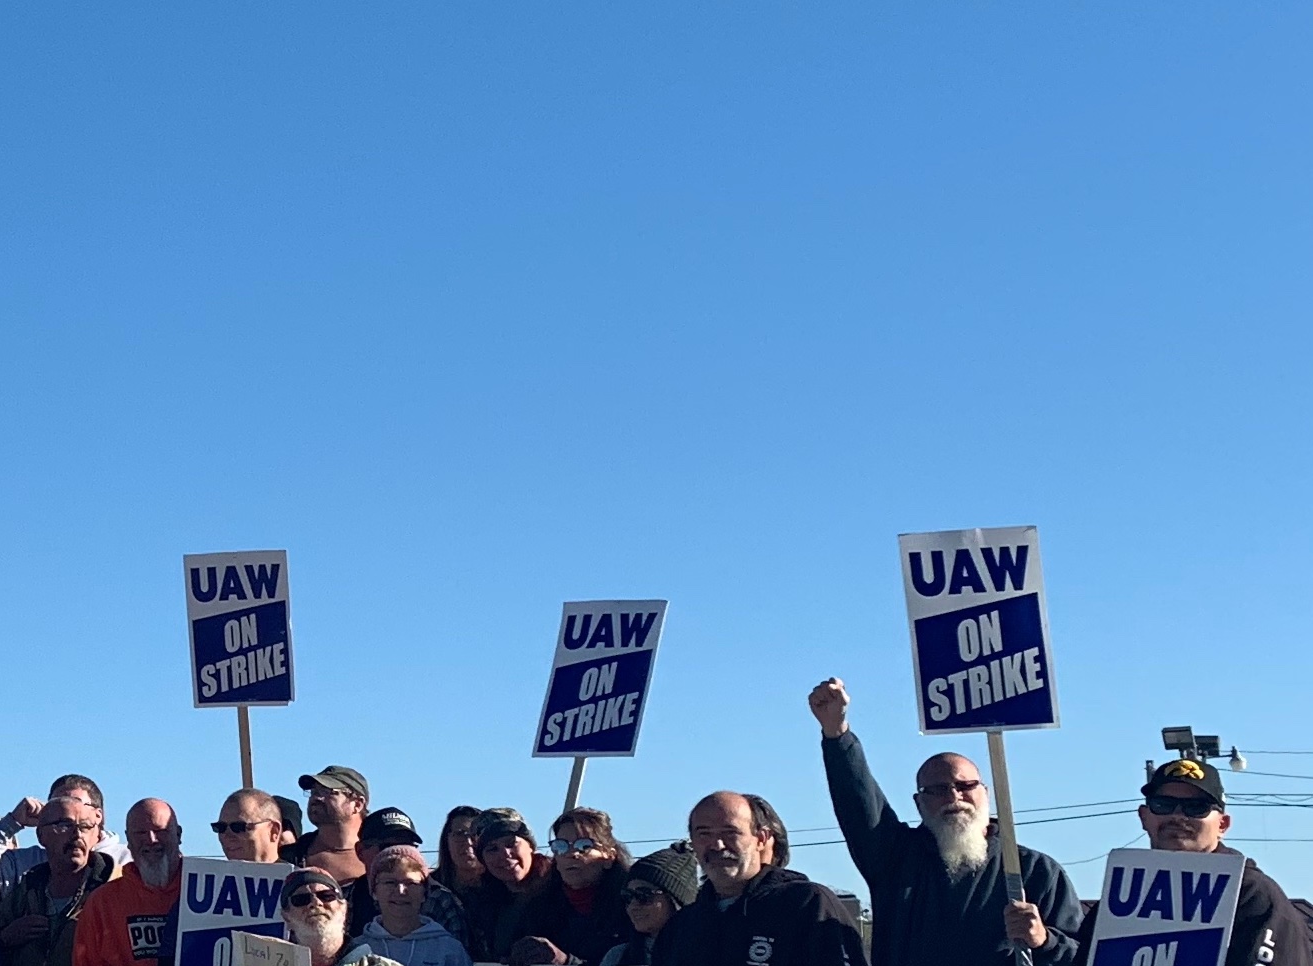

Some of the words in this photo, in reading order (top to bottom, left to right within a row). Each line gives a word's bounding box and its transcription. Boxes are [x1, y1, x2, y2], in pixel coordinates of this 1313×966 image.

[190, 564, 280, 603] UAW
[908, 544, 1029, 597] UAW
[223, 613, 258, 652] ON
[563, 612, 657, 649] UAW
[956, 611, 1002, 661] ON
[200, 643, 285, 698] STRIKE
[578, 662, 617, 699] ON
[928, 648, 1043, 721] STRIKE
[543, 691, 638, 748] STRIKE
[187, 873, 284, 918] UAW
[1109, 865, 1229, 924] UAW
